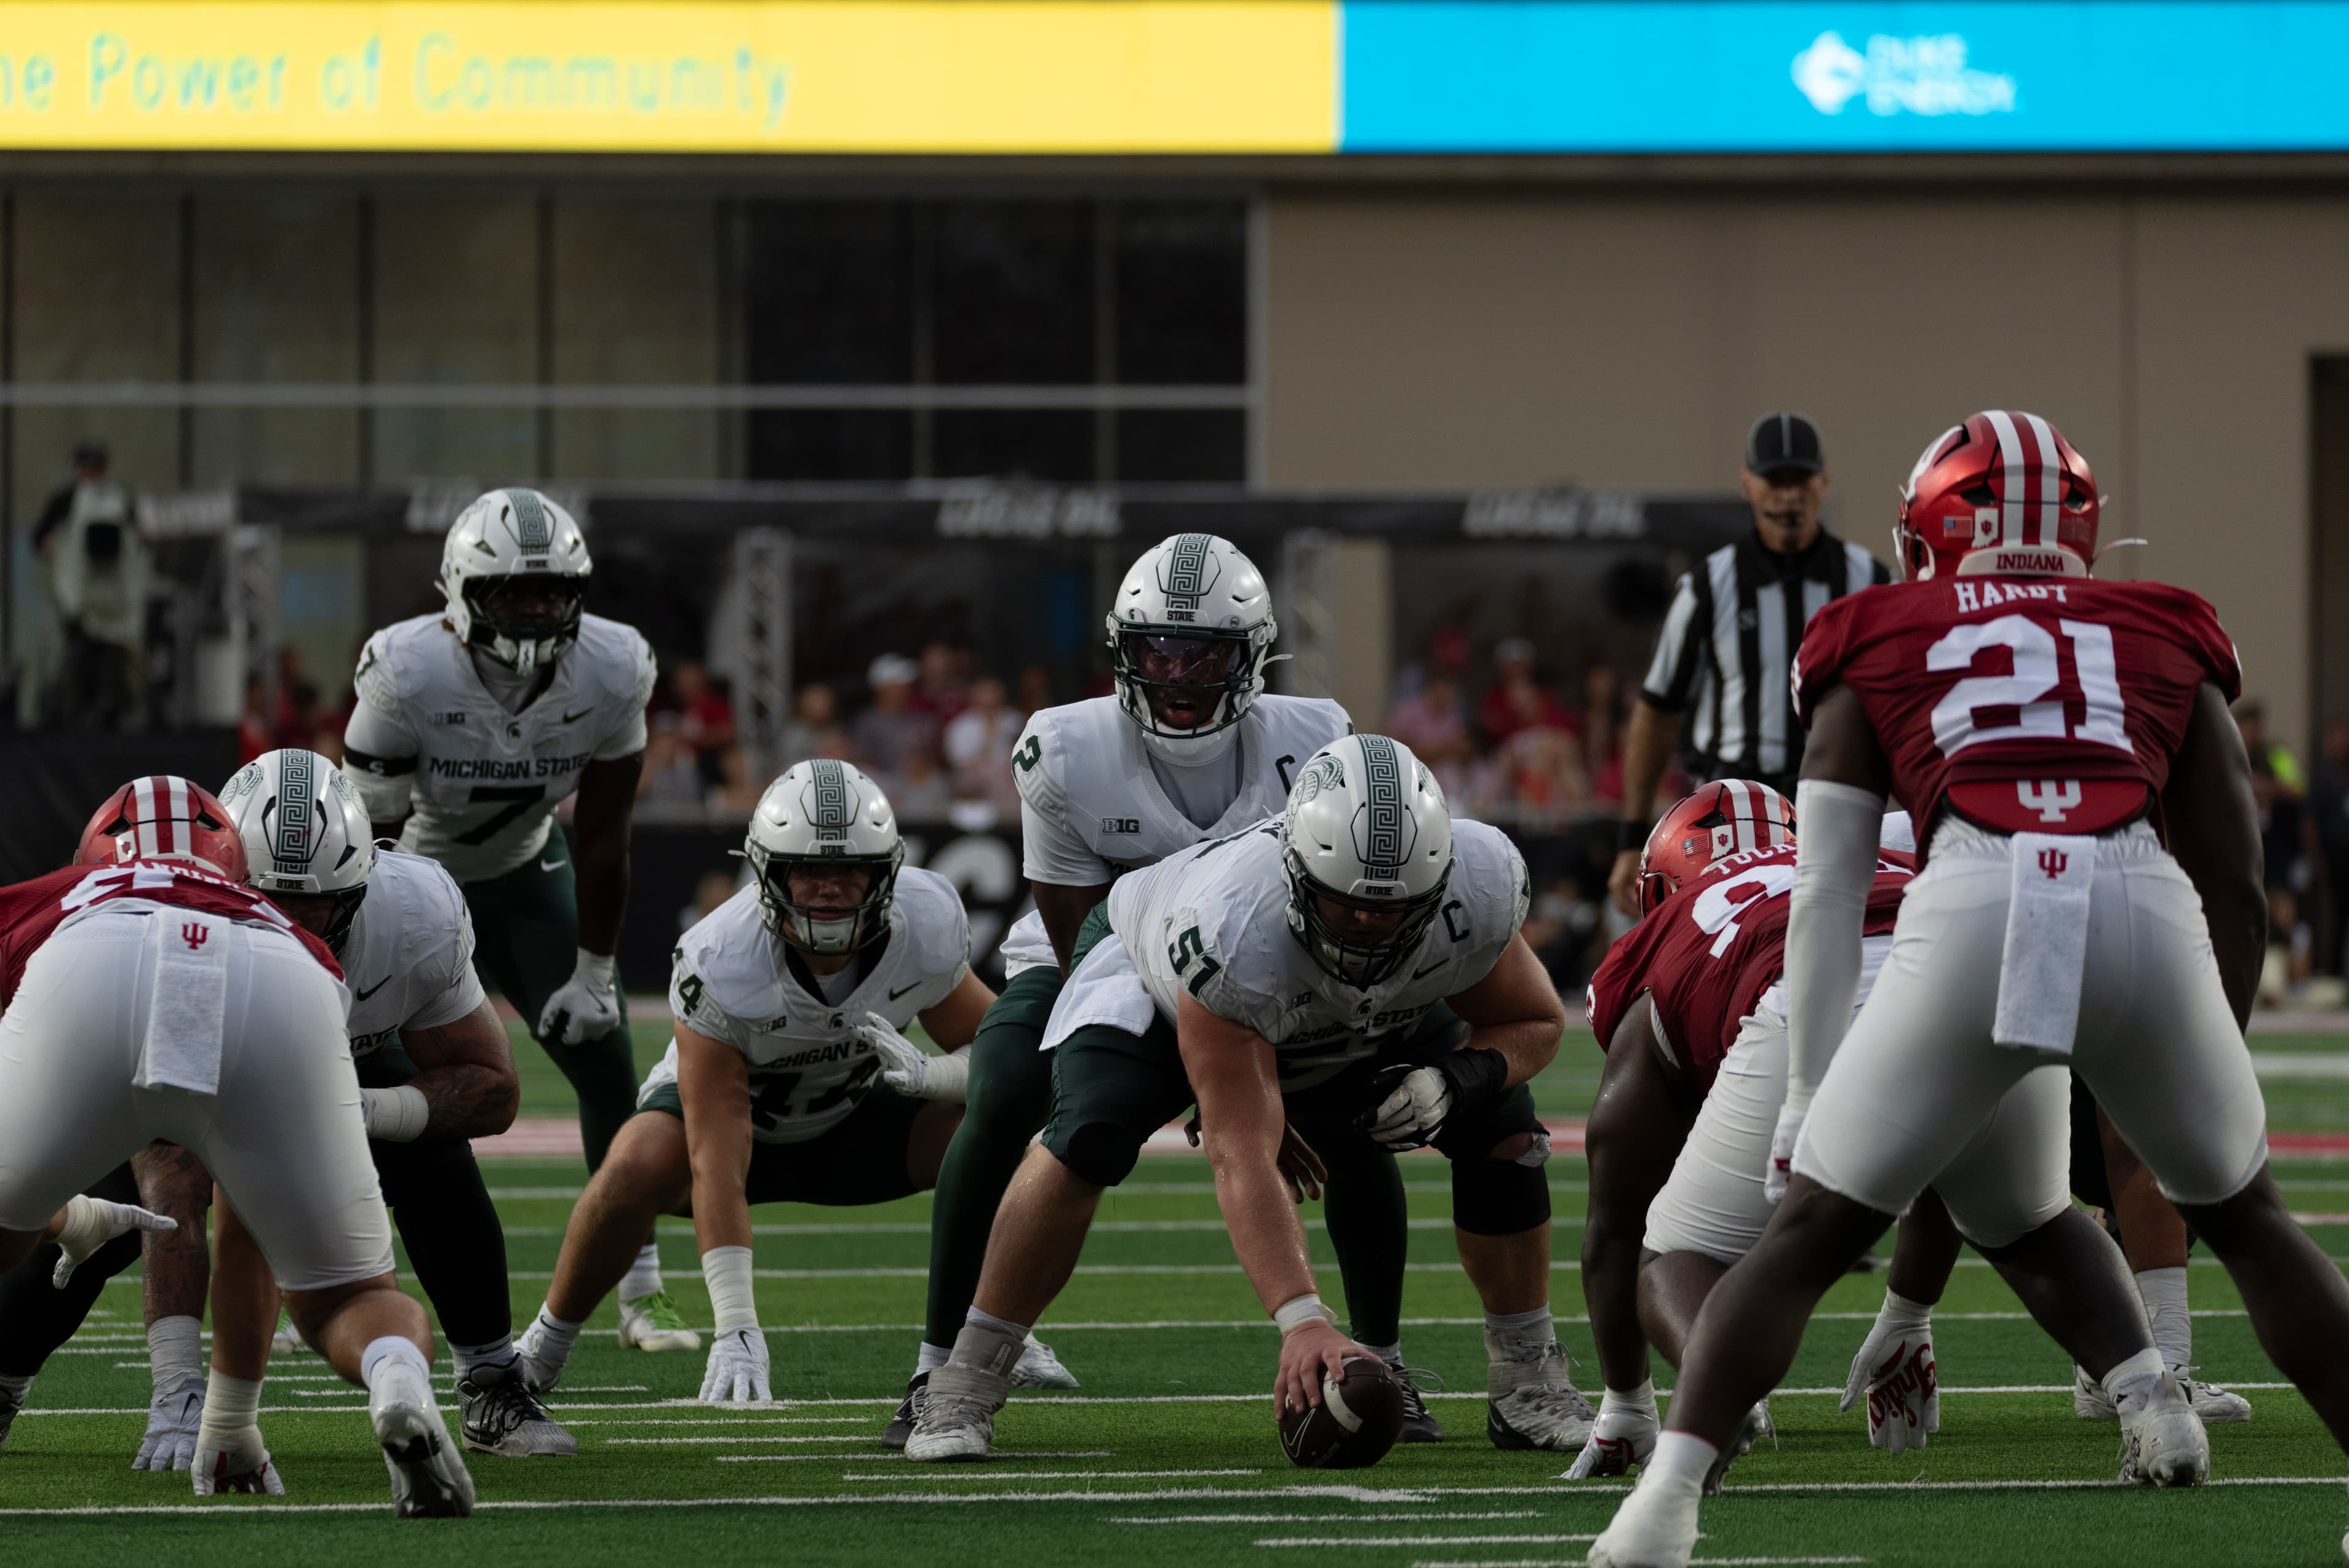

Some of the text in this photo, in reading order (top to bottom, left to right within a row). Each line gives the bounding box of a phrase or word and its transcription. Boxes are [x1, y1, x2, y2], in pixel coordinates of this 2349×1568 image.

[89, 32, 289, 113] Power
[319, 34, 383, 113] of
[1996, 554, 2065, 572] INDIANA
[1167, 610, 1195, 622] STATE
[1926, 613, 2135, 760] 21
[430, 751, 592, 780] MICHIGAN STATE
[451, 785, 545, 845] 7
[275, 878, 305, 890] STATE
[1365, 885, 1394, 896] STATE
[1442, 899, 1469, 943] C
[675, 948, 704, 1016] 4
[1168, 925, 1222, 998] 51
